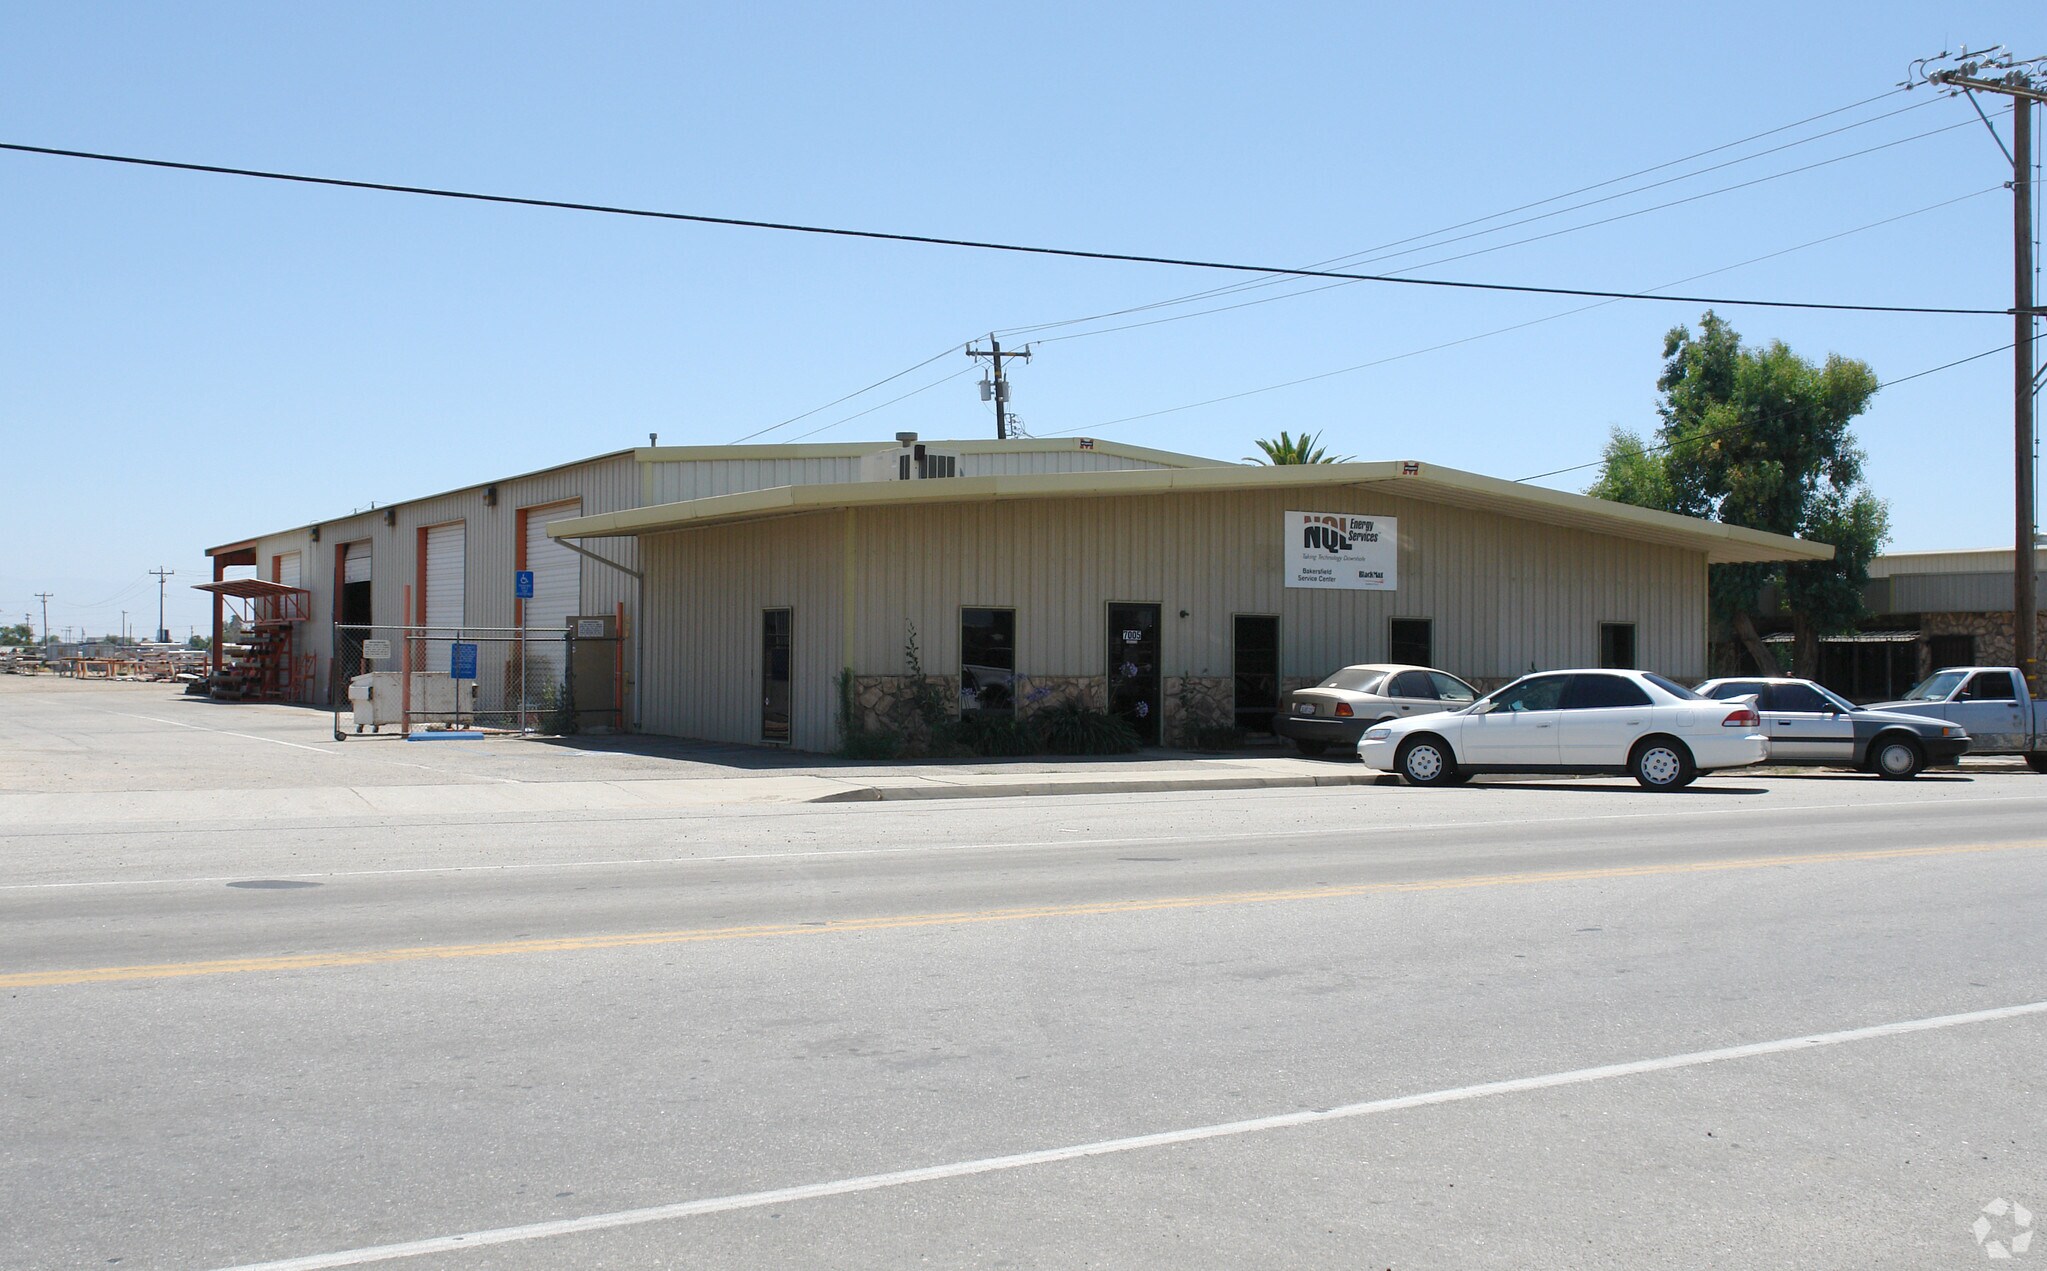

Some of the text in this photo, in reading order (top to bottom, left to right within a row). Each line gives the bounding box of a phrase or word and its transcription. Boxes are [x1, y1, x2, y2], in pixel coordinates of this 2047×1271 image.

[1350, 518, 1374, 531] Energy
[1304, 516, 1352, 553] NQL
[1348, 530, 1378, 542] Services
[1303, 553, 1317, 561] Taking
[1318, 553, 1342, 562] Technology
[1302, 567, 1332, 575] Bakersfield
[1123, 630, 1141, 640] 7005
